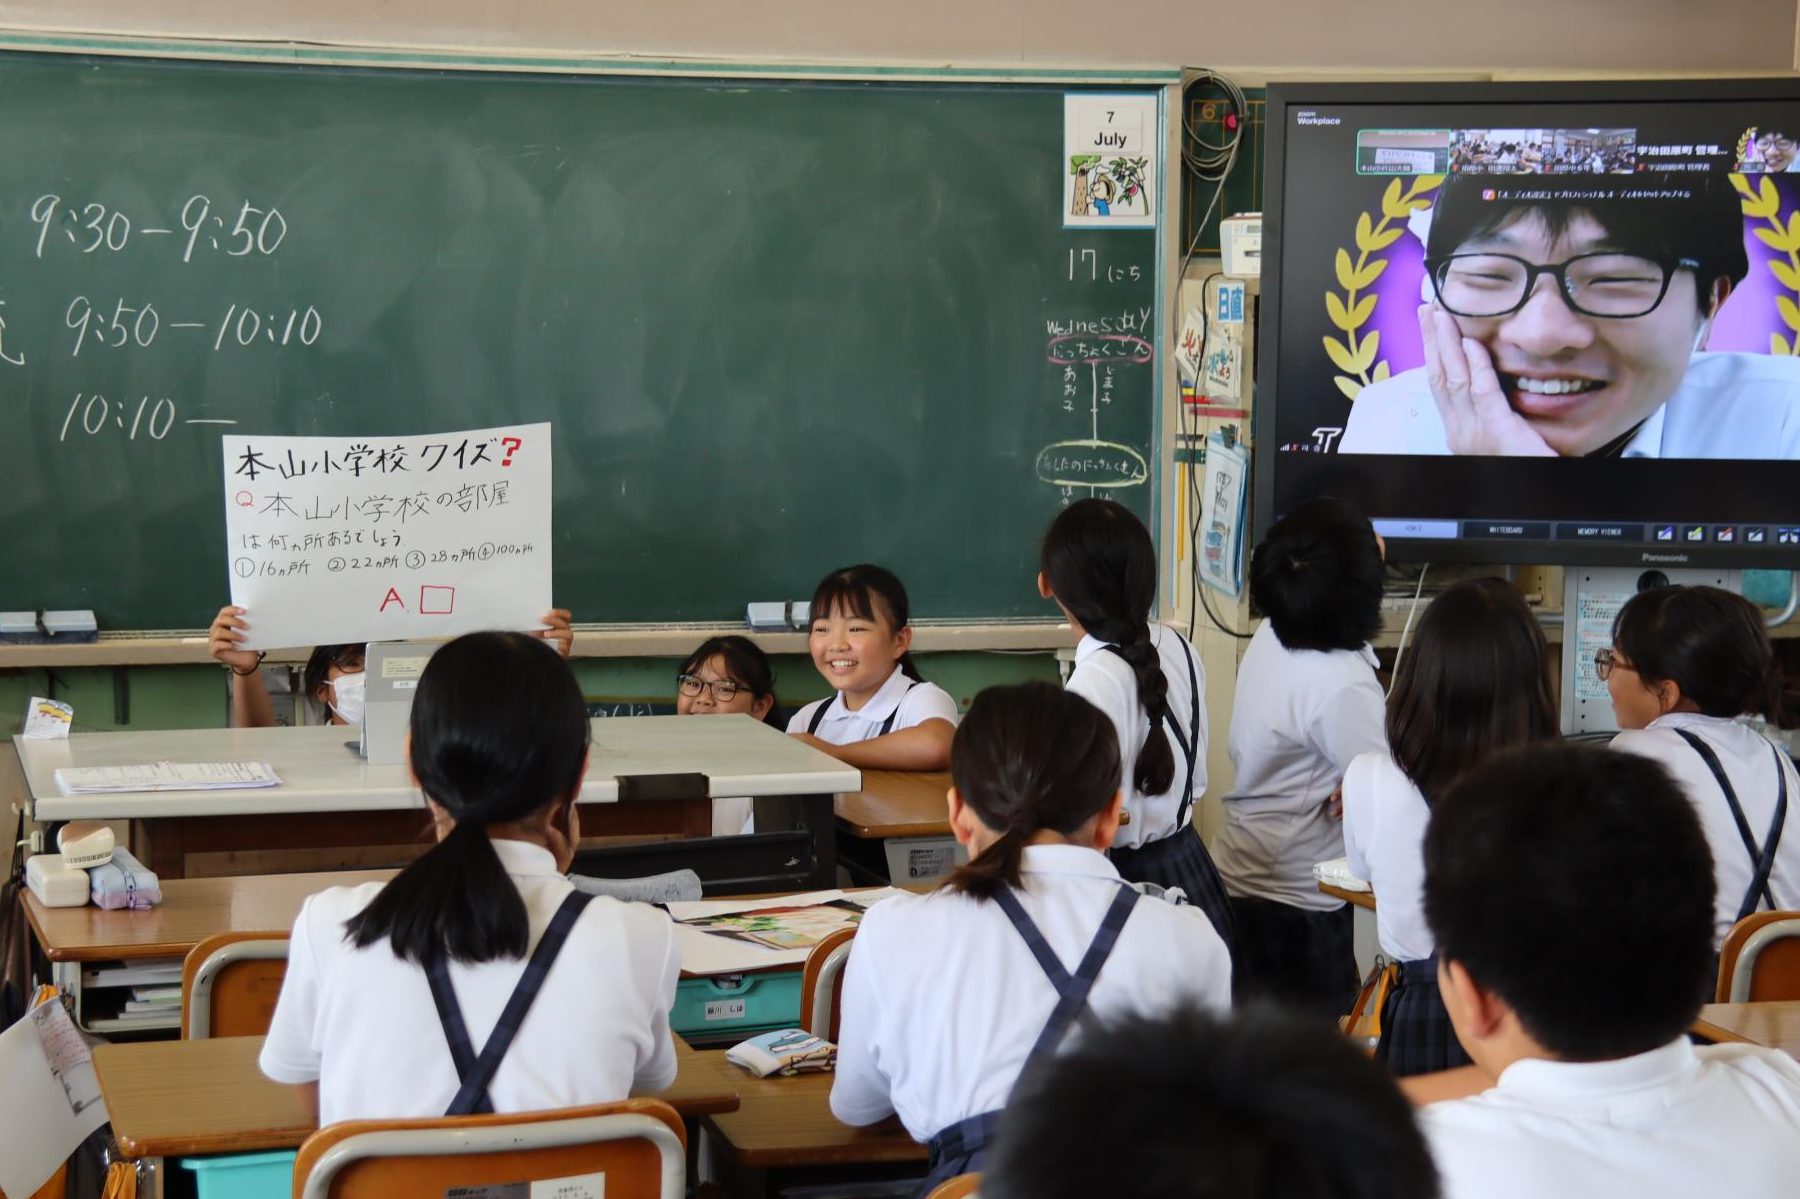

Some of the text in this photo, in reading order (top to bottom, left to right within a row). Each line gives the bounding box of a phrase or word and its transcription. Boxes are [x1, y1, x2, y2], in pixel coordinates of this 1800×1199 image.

[1106, 111, 1115, 123] 7
[1297, 117, 1341, 125] Workplace
[1094, 132, 1127, 149] July
[236, 441, 414, 480] 本山小学校
[235, 490, 254, 507] Q
[1489, 526, 1523, 534] WHITEBOARD
[1577, 527, 1622, 536] MEMORY VIEWER
[1642, 553, 1688, 562] Panasonic
